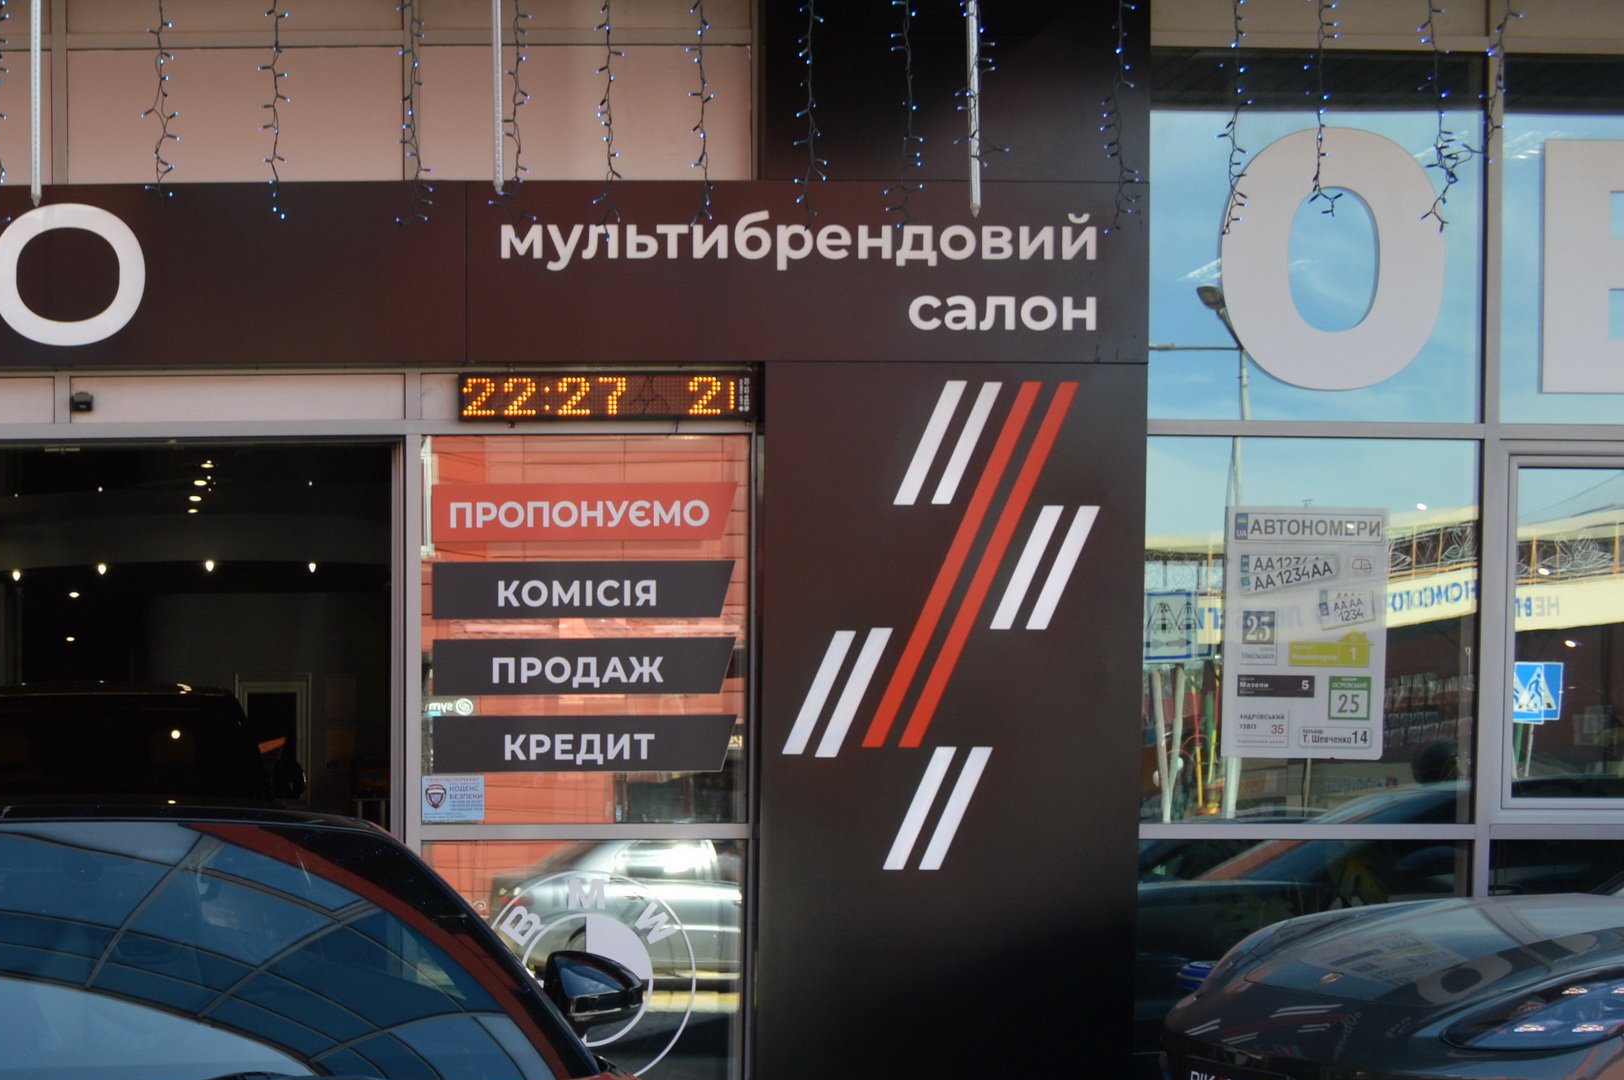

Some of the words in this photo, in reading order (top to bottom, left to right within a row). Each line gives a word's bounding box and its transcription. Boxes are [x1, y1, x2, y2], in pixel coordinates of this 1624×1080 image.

[500, 210, 1097, 271] мультибрендовий
[908, 294, 1097, 332] салон
[461, 376, 627, 417] 22:27
[449, 500, 710, 529] ПРОПОНУЄМО
[1250, 519, 1381, 537] АВТОНОМЕРИ
[497, 579, 657, 608] КОМІСІЯ
[1245, 615, 1271, 641] 25
[1349, 647, 1357, 660] 1
[491, 655, 665, 689] ПРОДАЖ
[1301, 679, 1310, 690] 5
[1337, 693, 1360, 714] 25
[1270, 724, 1284, 735] 35
[1311, 734, 1352, 744] Шевченко
[1352, 730, 1368, 744] 14
[503, 732, 656, 766] КРЕДИТ
